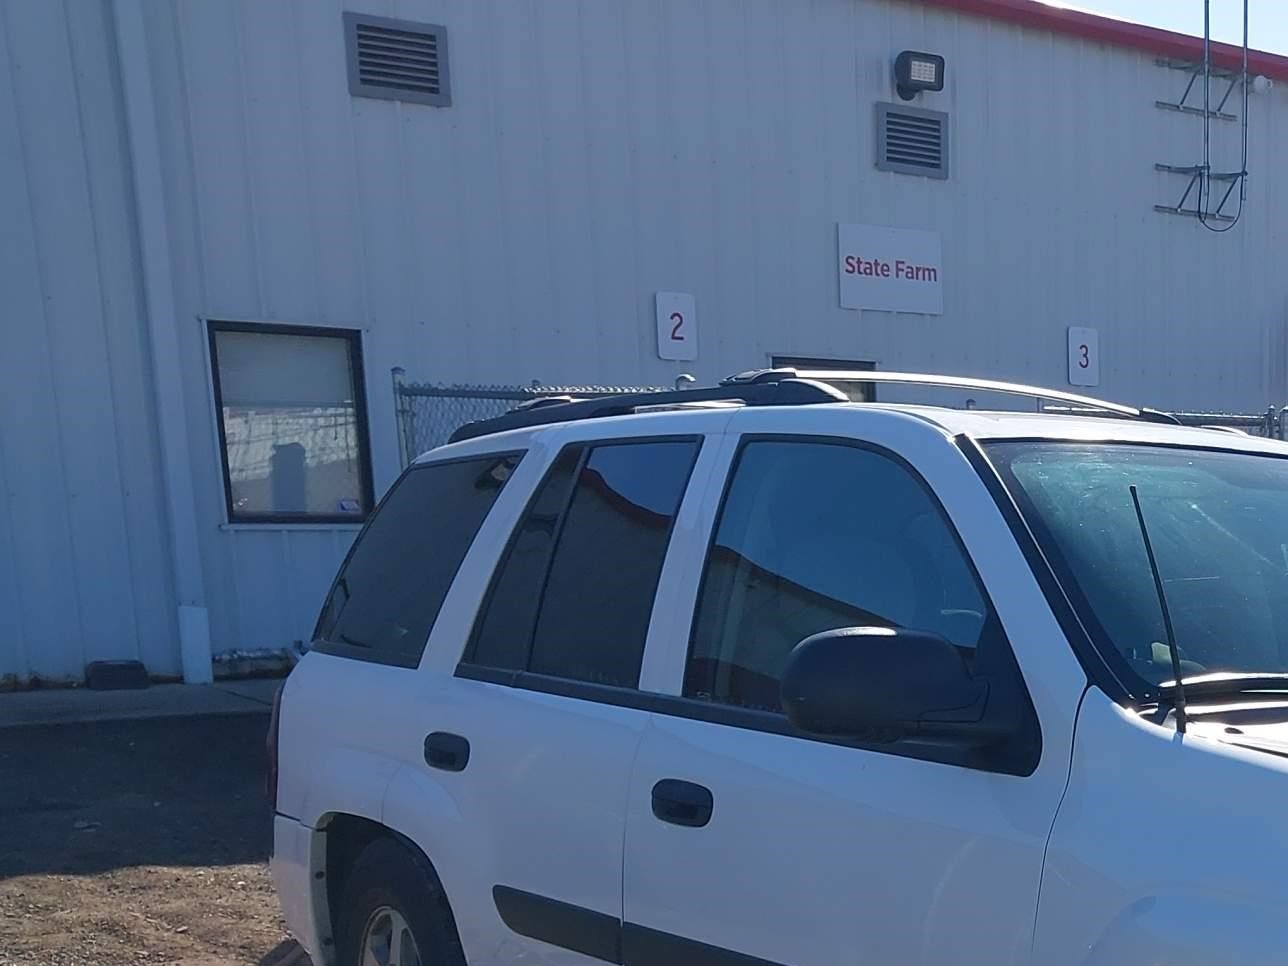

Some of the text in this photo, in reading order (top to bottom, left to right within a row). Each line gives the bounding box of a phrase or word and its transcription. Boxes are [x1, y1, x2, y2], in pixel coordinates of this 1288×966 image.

[845, 255, 937, 282] State Farm
[670, 312, 684, 341] 2
[1079, 344, 1089, 369] 3
